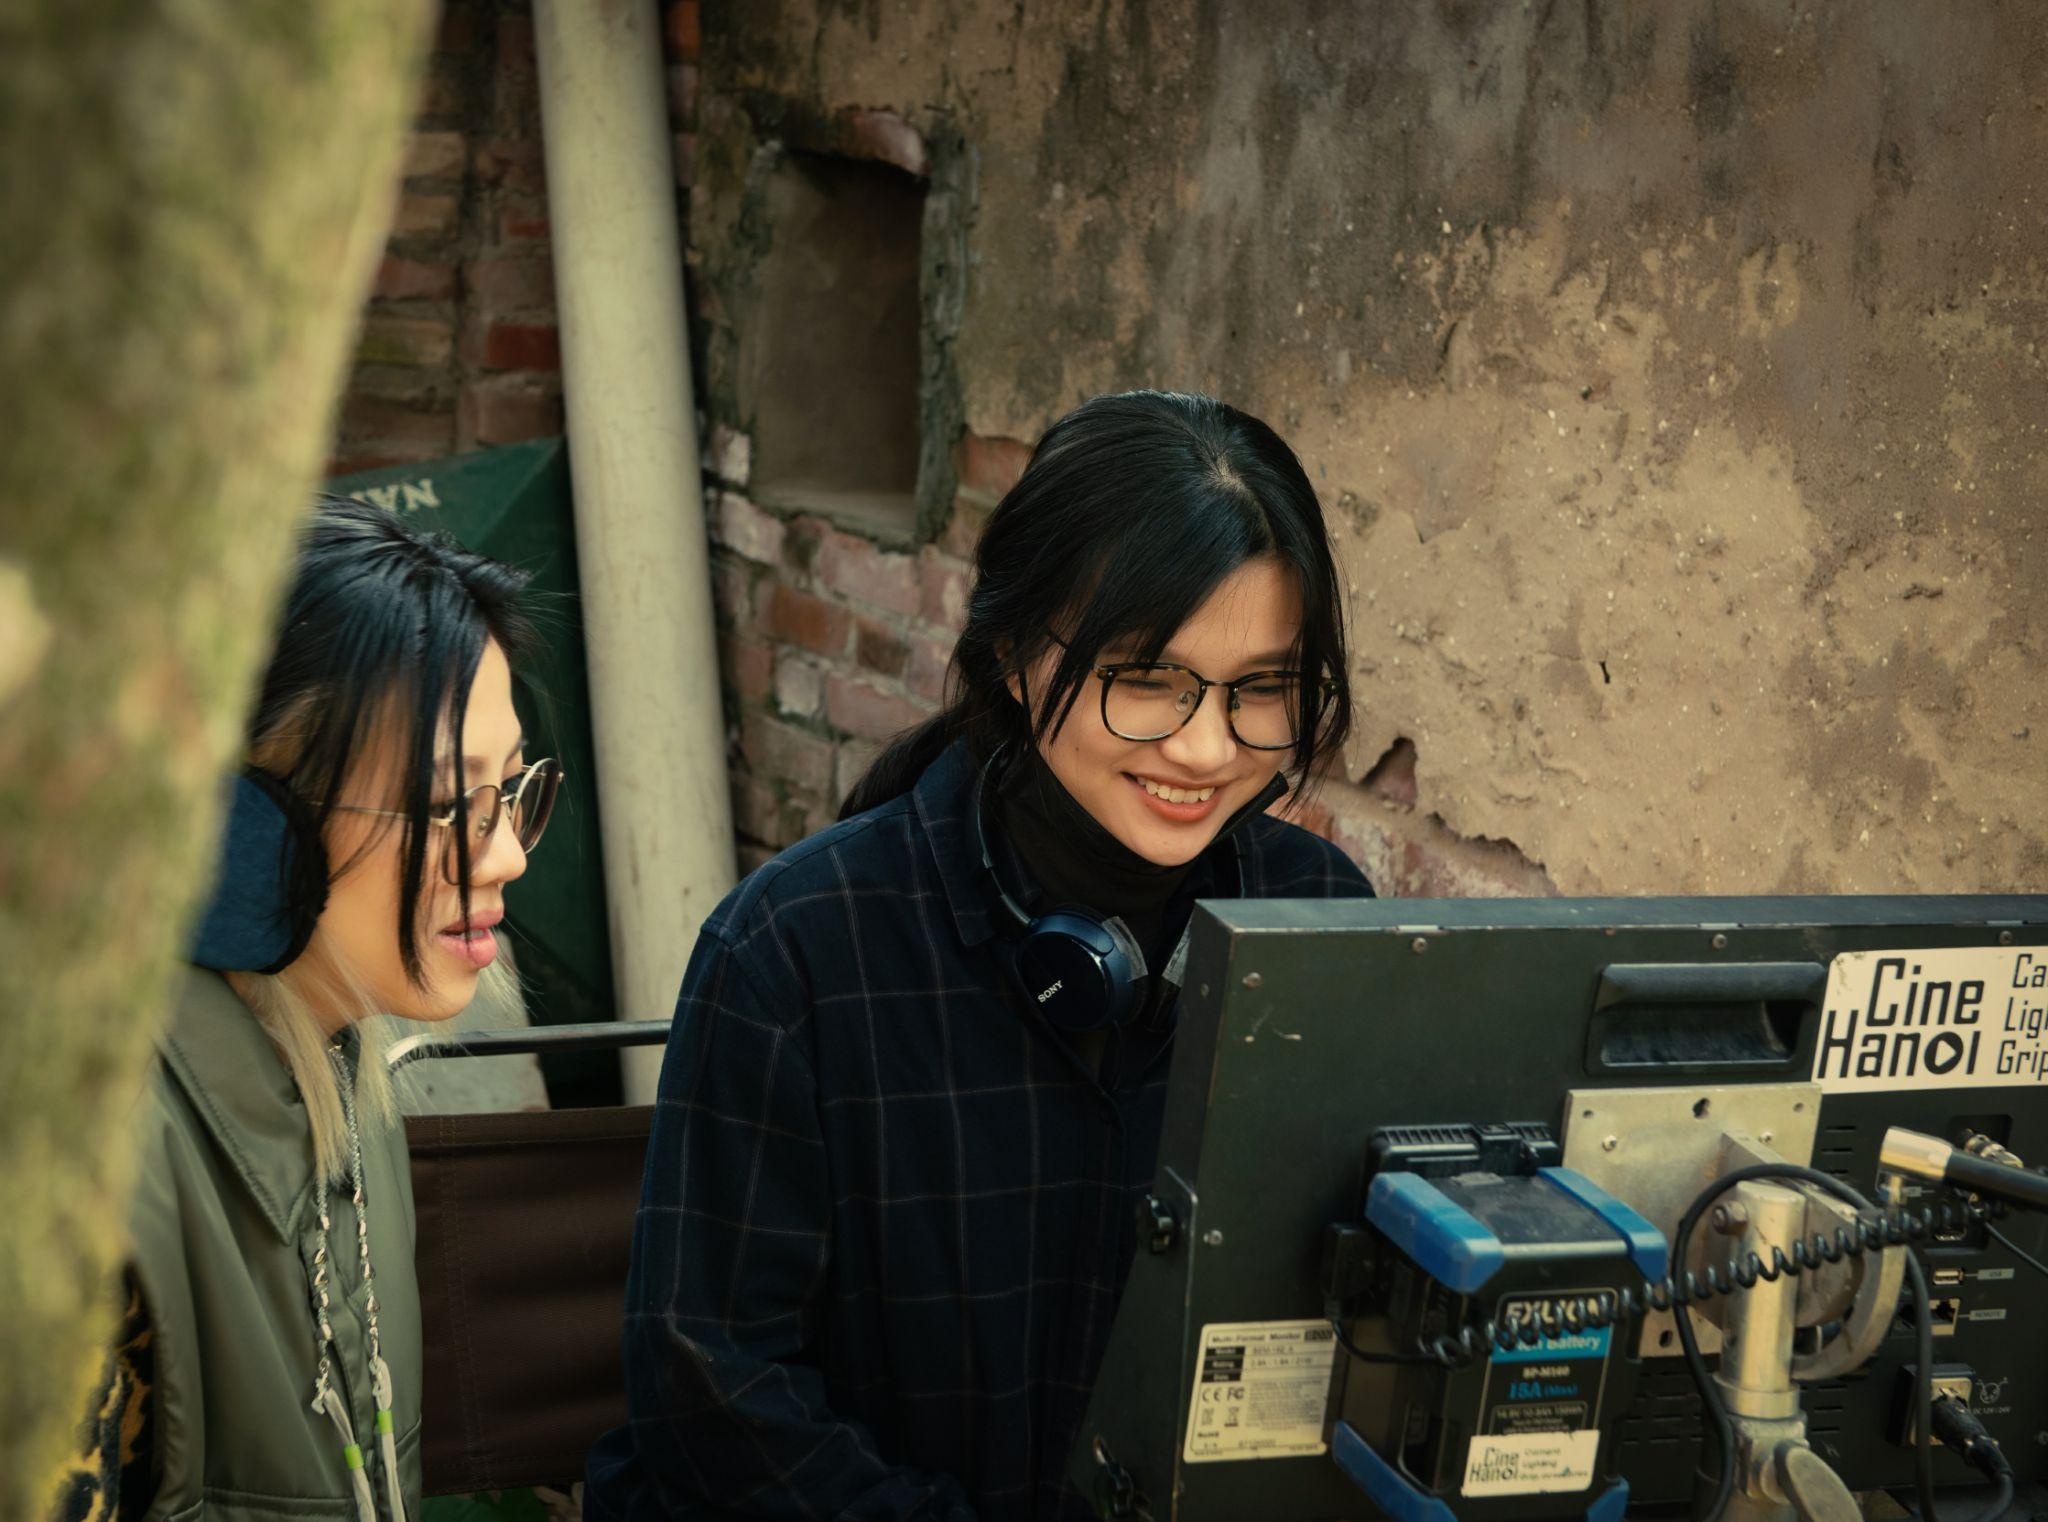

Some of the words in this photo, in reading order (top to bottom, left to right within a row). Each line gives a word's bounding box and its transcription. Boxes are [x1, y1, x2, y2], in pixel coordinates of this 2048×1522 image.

[351, 478, 441, 511] NA
[2013, 953, 2048, 988] Ca
[1037, 979, 1063, 1003] SONY
[1866, 957, 1985, 1027] Cine
[2004, 996, 2048, 1039] Lig
[1484, 1447, 1519, 1468] Cine
